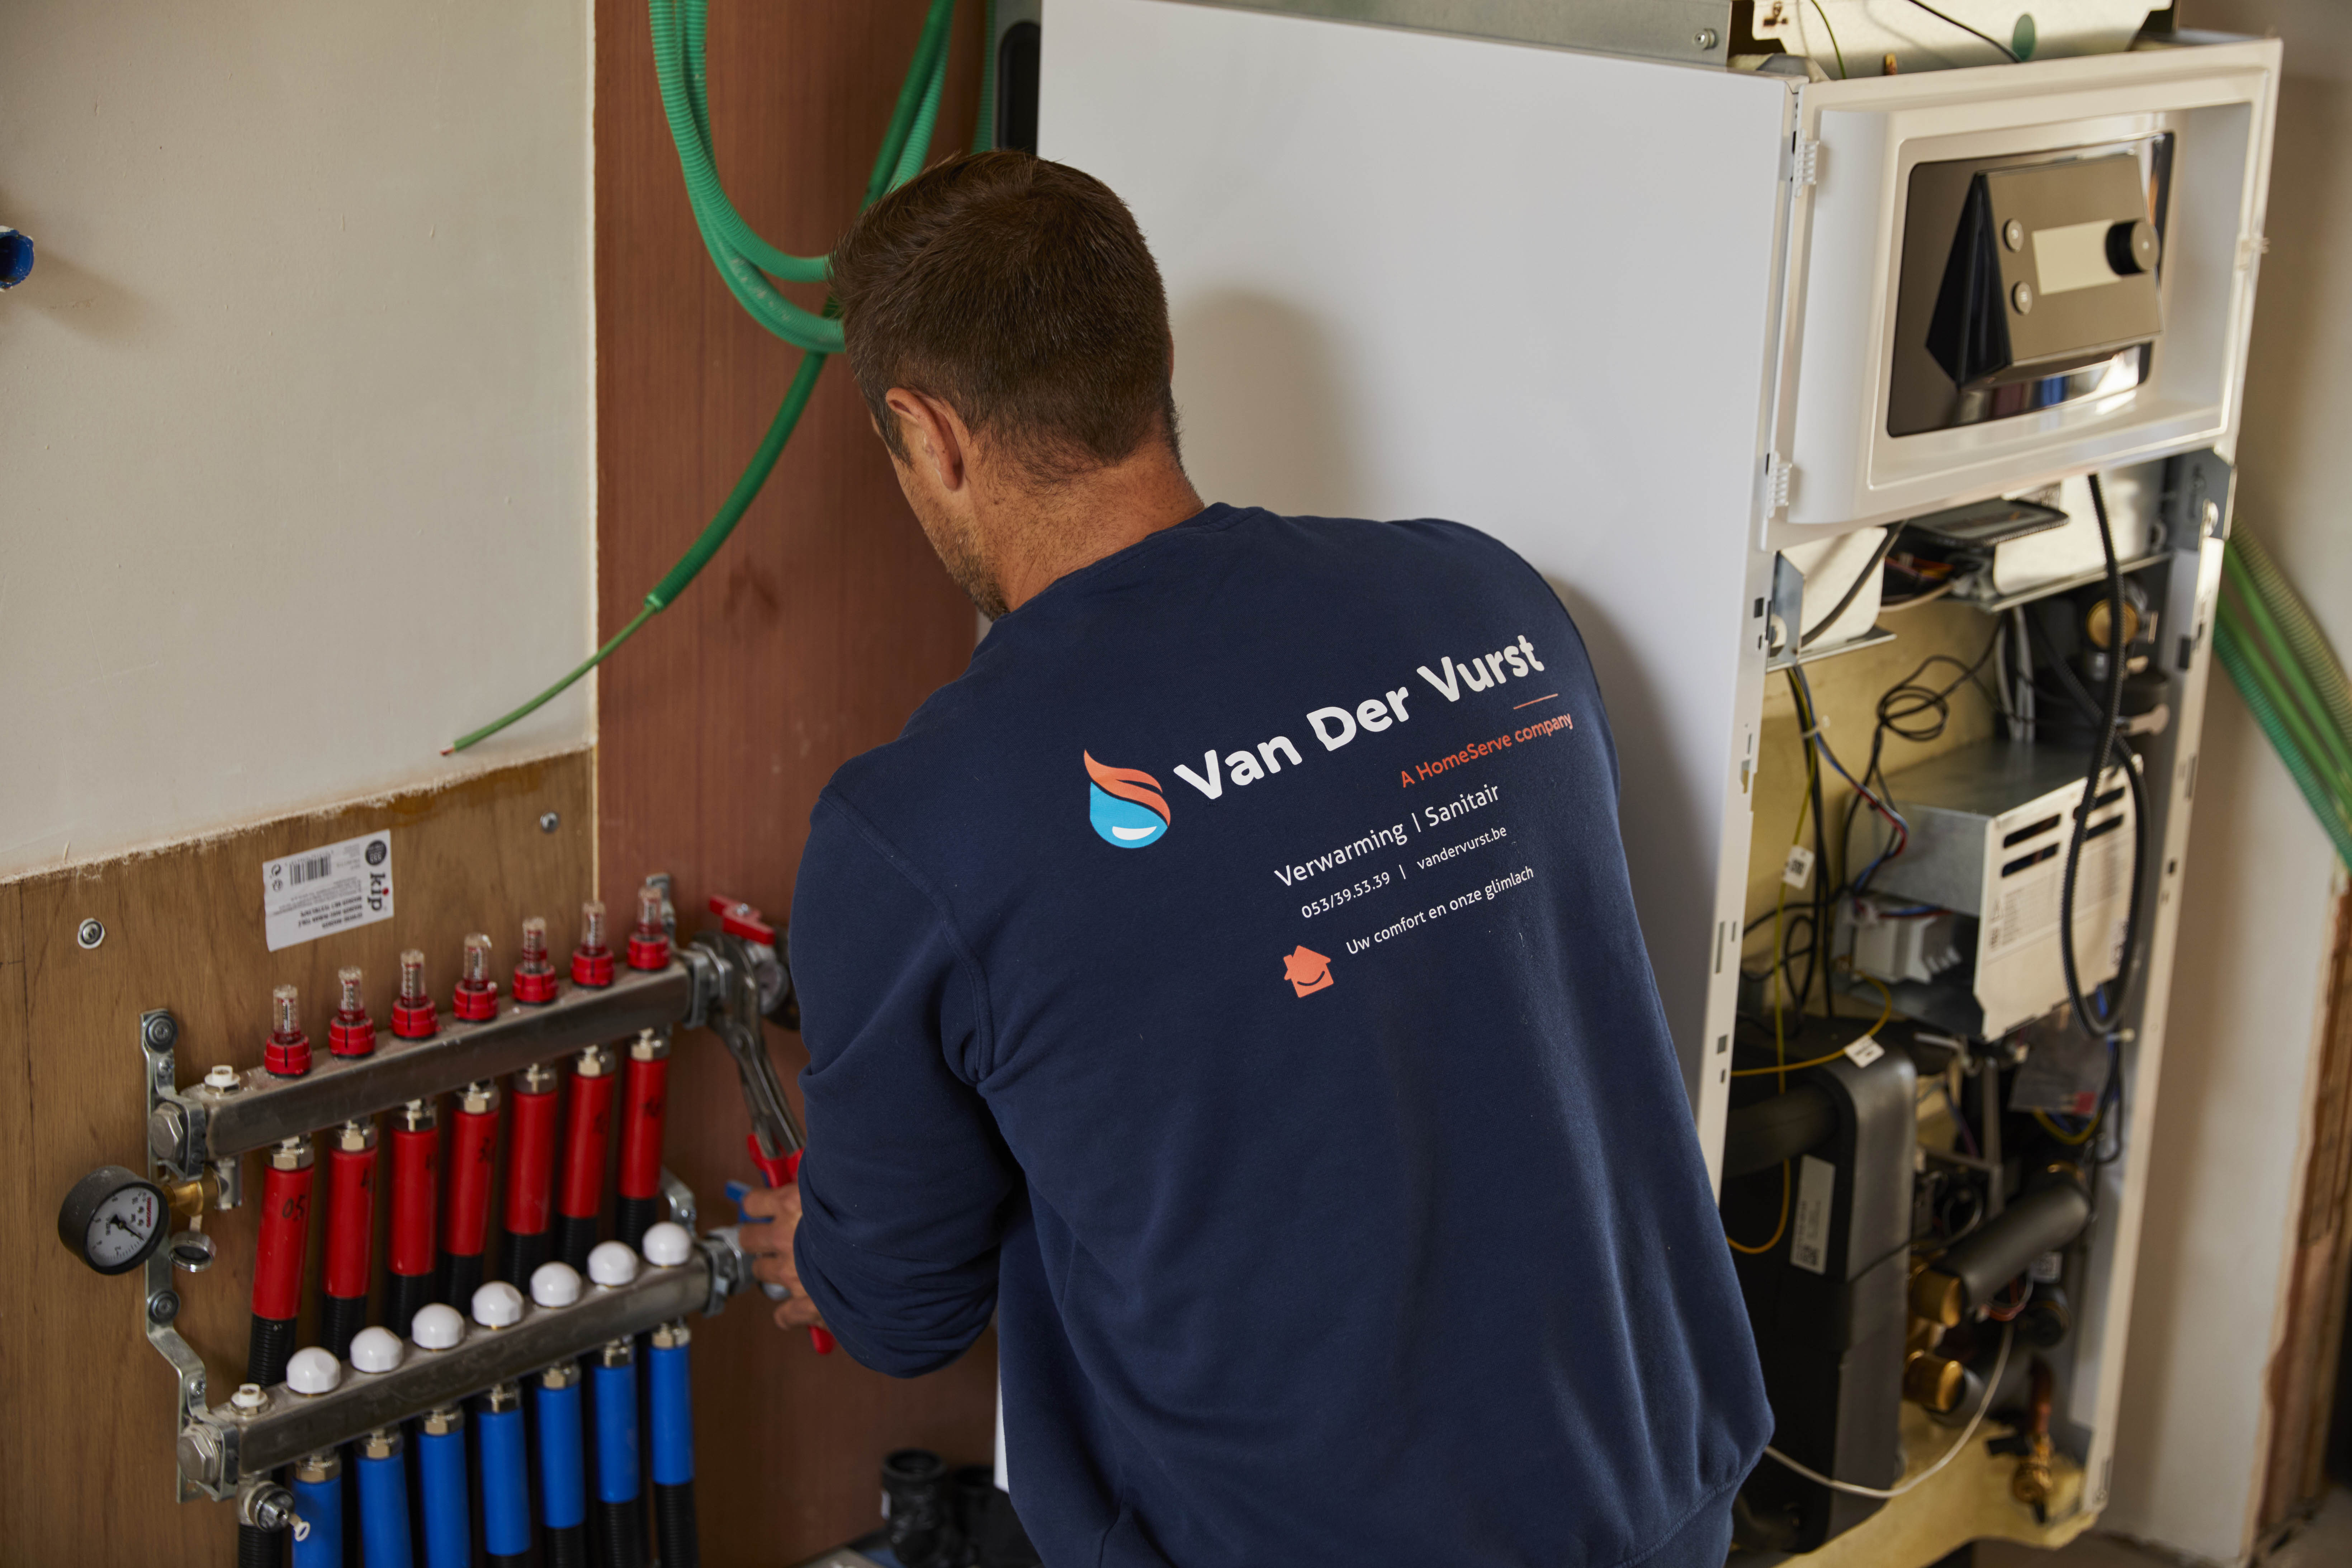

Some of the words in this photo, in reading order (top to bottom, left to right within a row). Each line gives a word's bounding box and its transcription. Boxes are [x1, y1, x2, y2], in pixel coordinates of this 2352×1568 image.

[1173, 736, 1302, 800] Van
[1306, 687, 1409, 752] Der
[1416, 635, 1545, 702] Vurst
[1401, 771, 1415, 788] A
[1415, 735, 1512, 781] HomeServe
[1514, 713, 1573, 743] company
[1274, 823, 1407, 886] Verwarming
[1425, 784, 1498, 826] Sanitair
[1302, 872, 1390, 918] 053/39.53.39
[1416, 827, 1507, 870] vandervurst.be
[366, 872, 389, 911] kip
[1346, 937, 1370, 954] Uw
[1374, 911, 1426, 943] comfort
[1429, 905, 1447, 919] en
[1449, 890, 1482, 910] onze
[1485, 866, 1534, 900] glimlach
